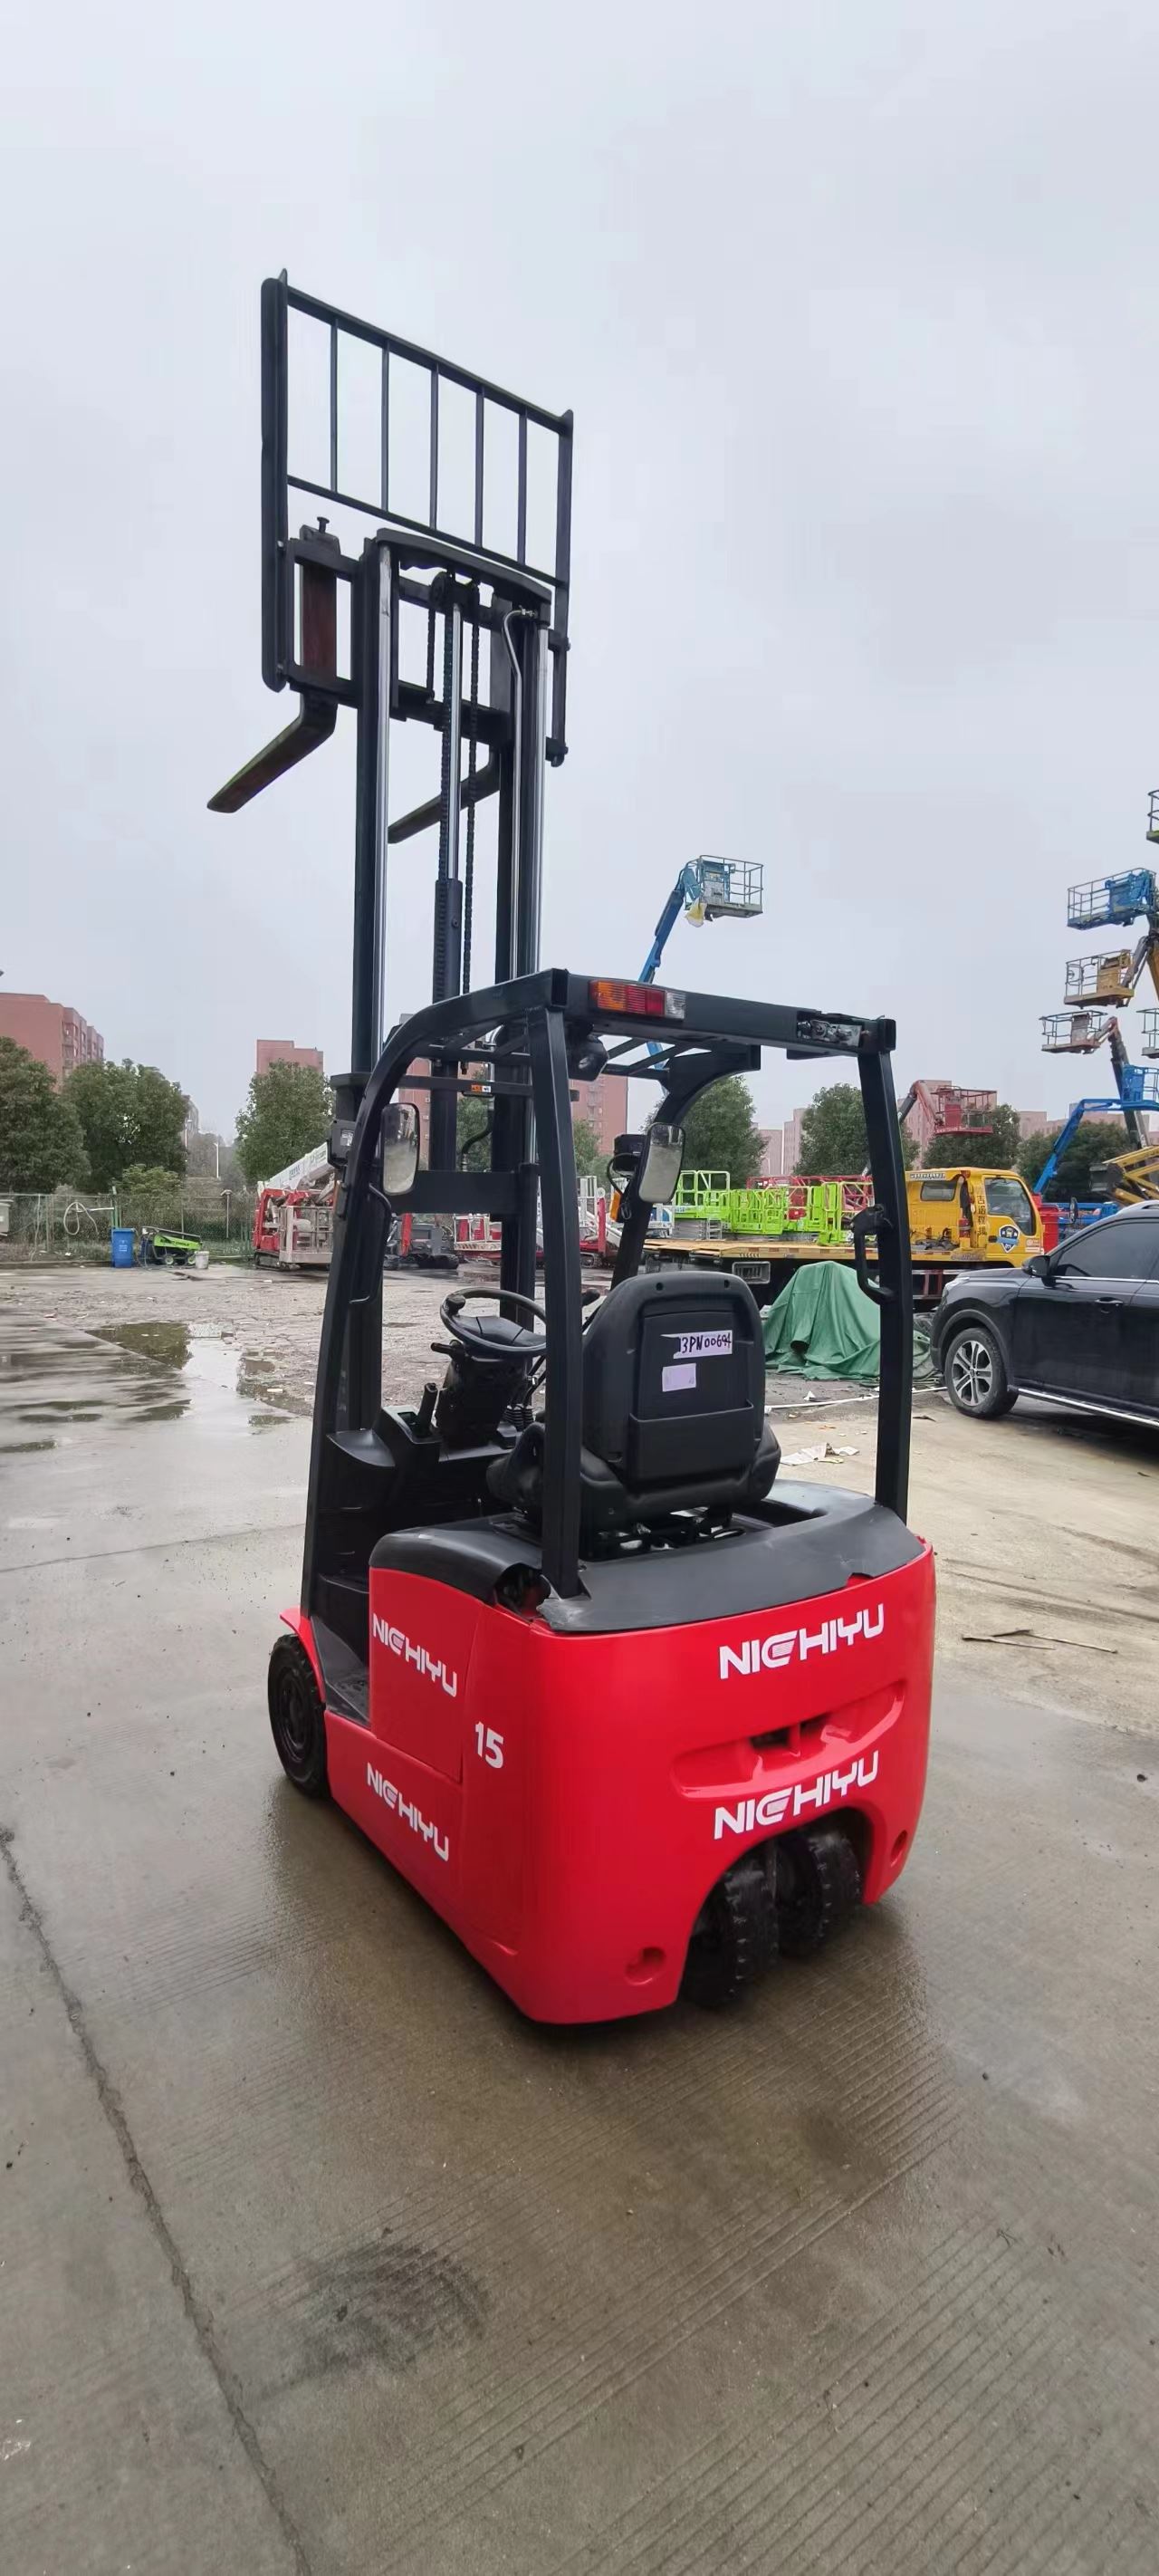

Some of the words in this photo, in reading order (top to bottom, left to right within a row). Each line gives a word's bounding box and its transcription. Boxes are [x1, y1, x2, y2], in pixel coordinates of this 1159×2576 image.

[372, 1613, 457, 1697] NICHIYU
[719, 1603, 885, 1679] NICHIYU
[474, 1721, 504, 1769] 15
[367, 1763, 449, 1861] NICHIYU
[714, 1750, 879, 1840] NICHIYU
